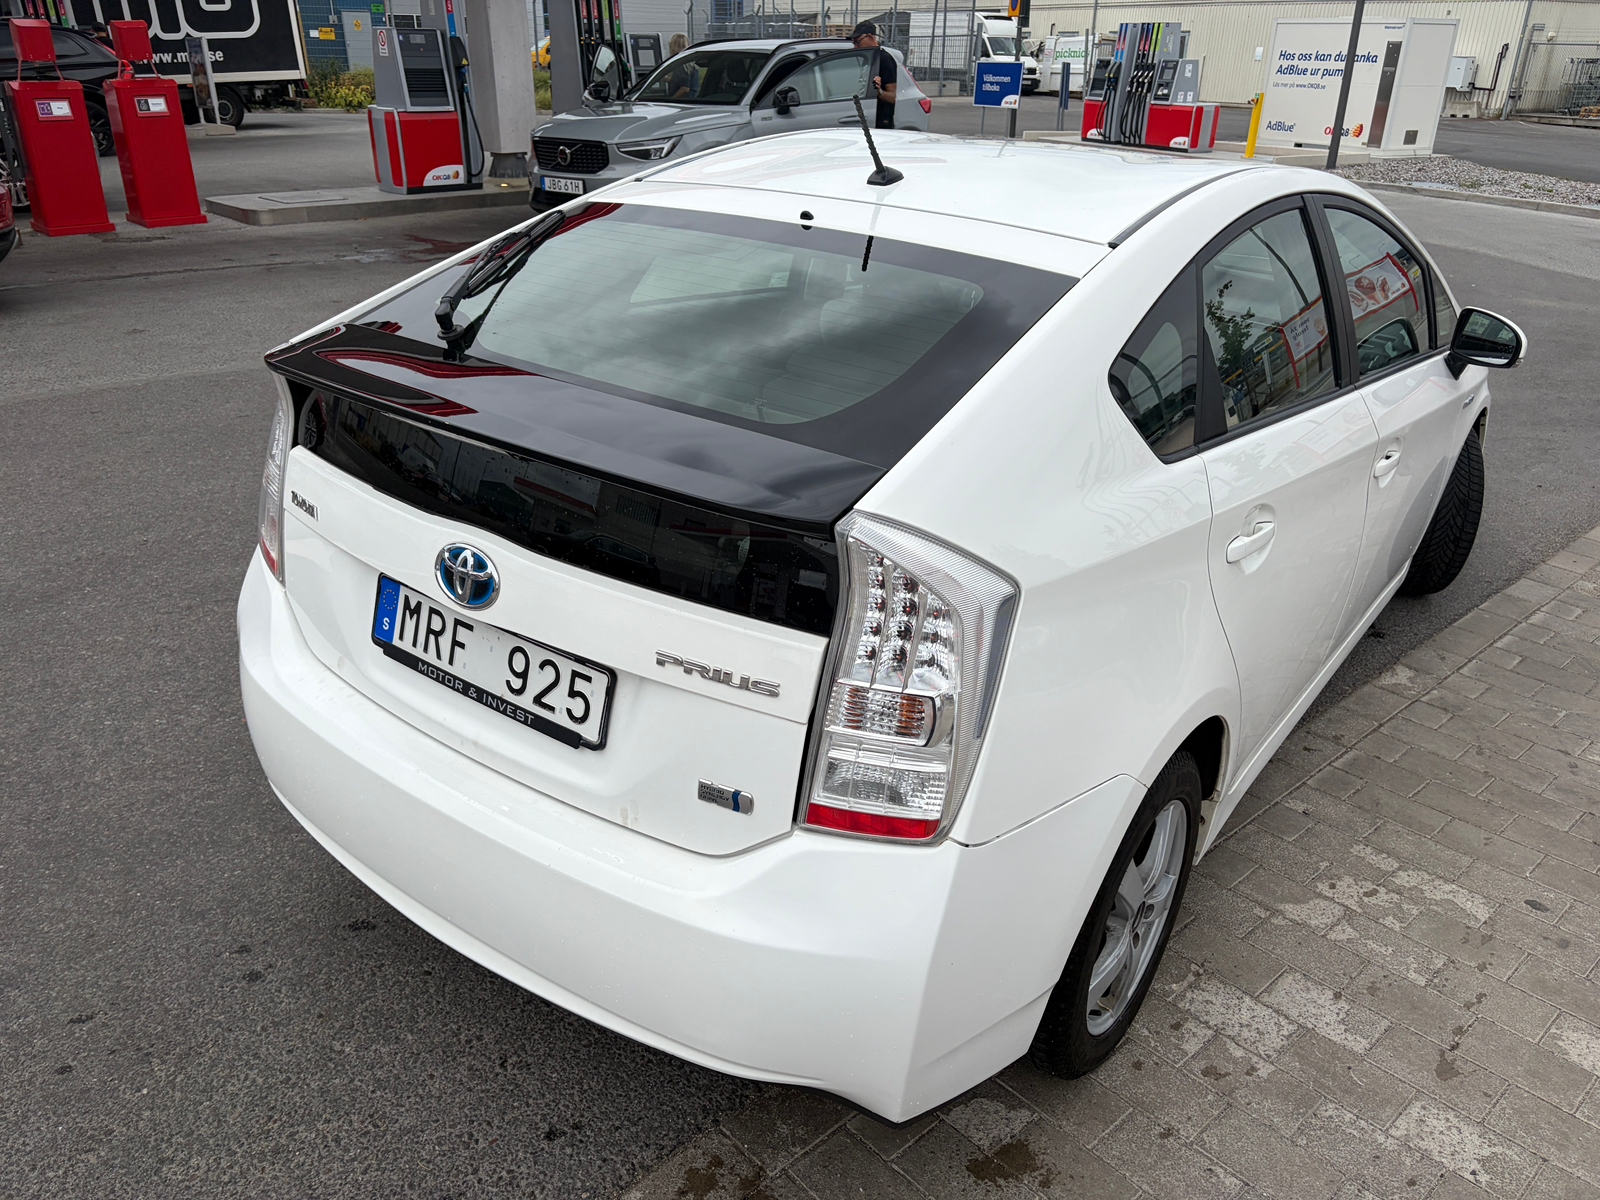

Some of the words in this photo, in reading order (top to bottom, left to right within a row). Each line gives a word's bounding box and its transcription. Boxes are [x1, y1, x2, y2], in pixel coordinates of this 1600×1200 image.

[1278, 50, 1296, 61] Hos
[1297, 53, 1313, 61] oss
[1314, 50, 1332, 62] kan
[1333, 51, 1347, 62] du
[1354, 51, 1379, 63] anka
[983, 74, 1011, 82] Välkommen
[1275, 64, 1309, 76] AdBlue
[1310, 68, 1321, 76] ur
[1320, 68, 1345, 79] pum
[547, 179, 562, 191] JBG
[563, 180, 580, 192] 61H
[382, 617, 390, 630] S
[399, 594, 474, 666] MRF
[505, 645, 593, 725] 925
[655, 649, 781, 698] PRIUS
[418, 661, 463, 692] MOTOR
[468, 686, 478, 699] &
[483, 693, 535, 725] INVEST
